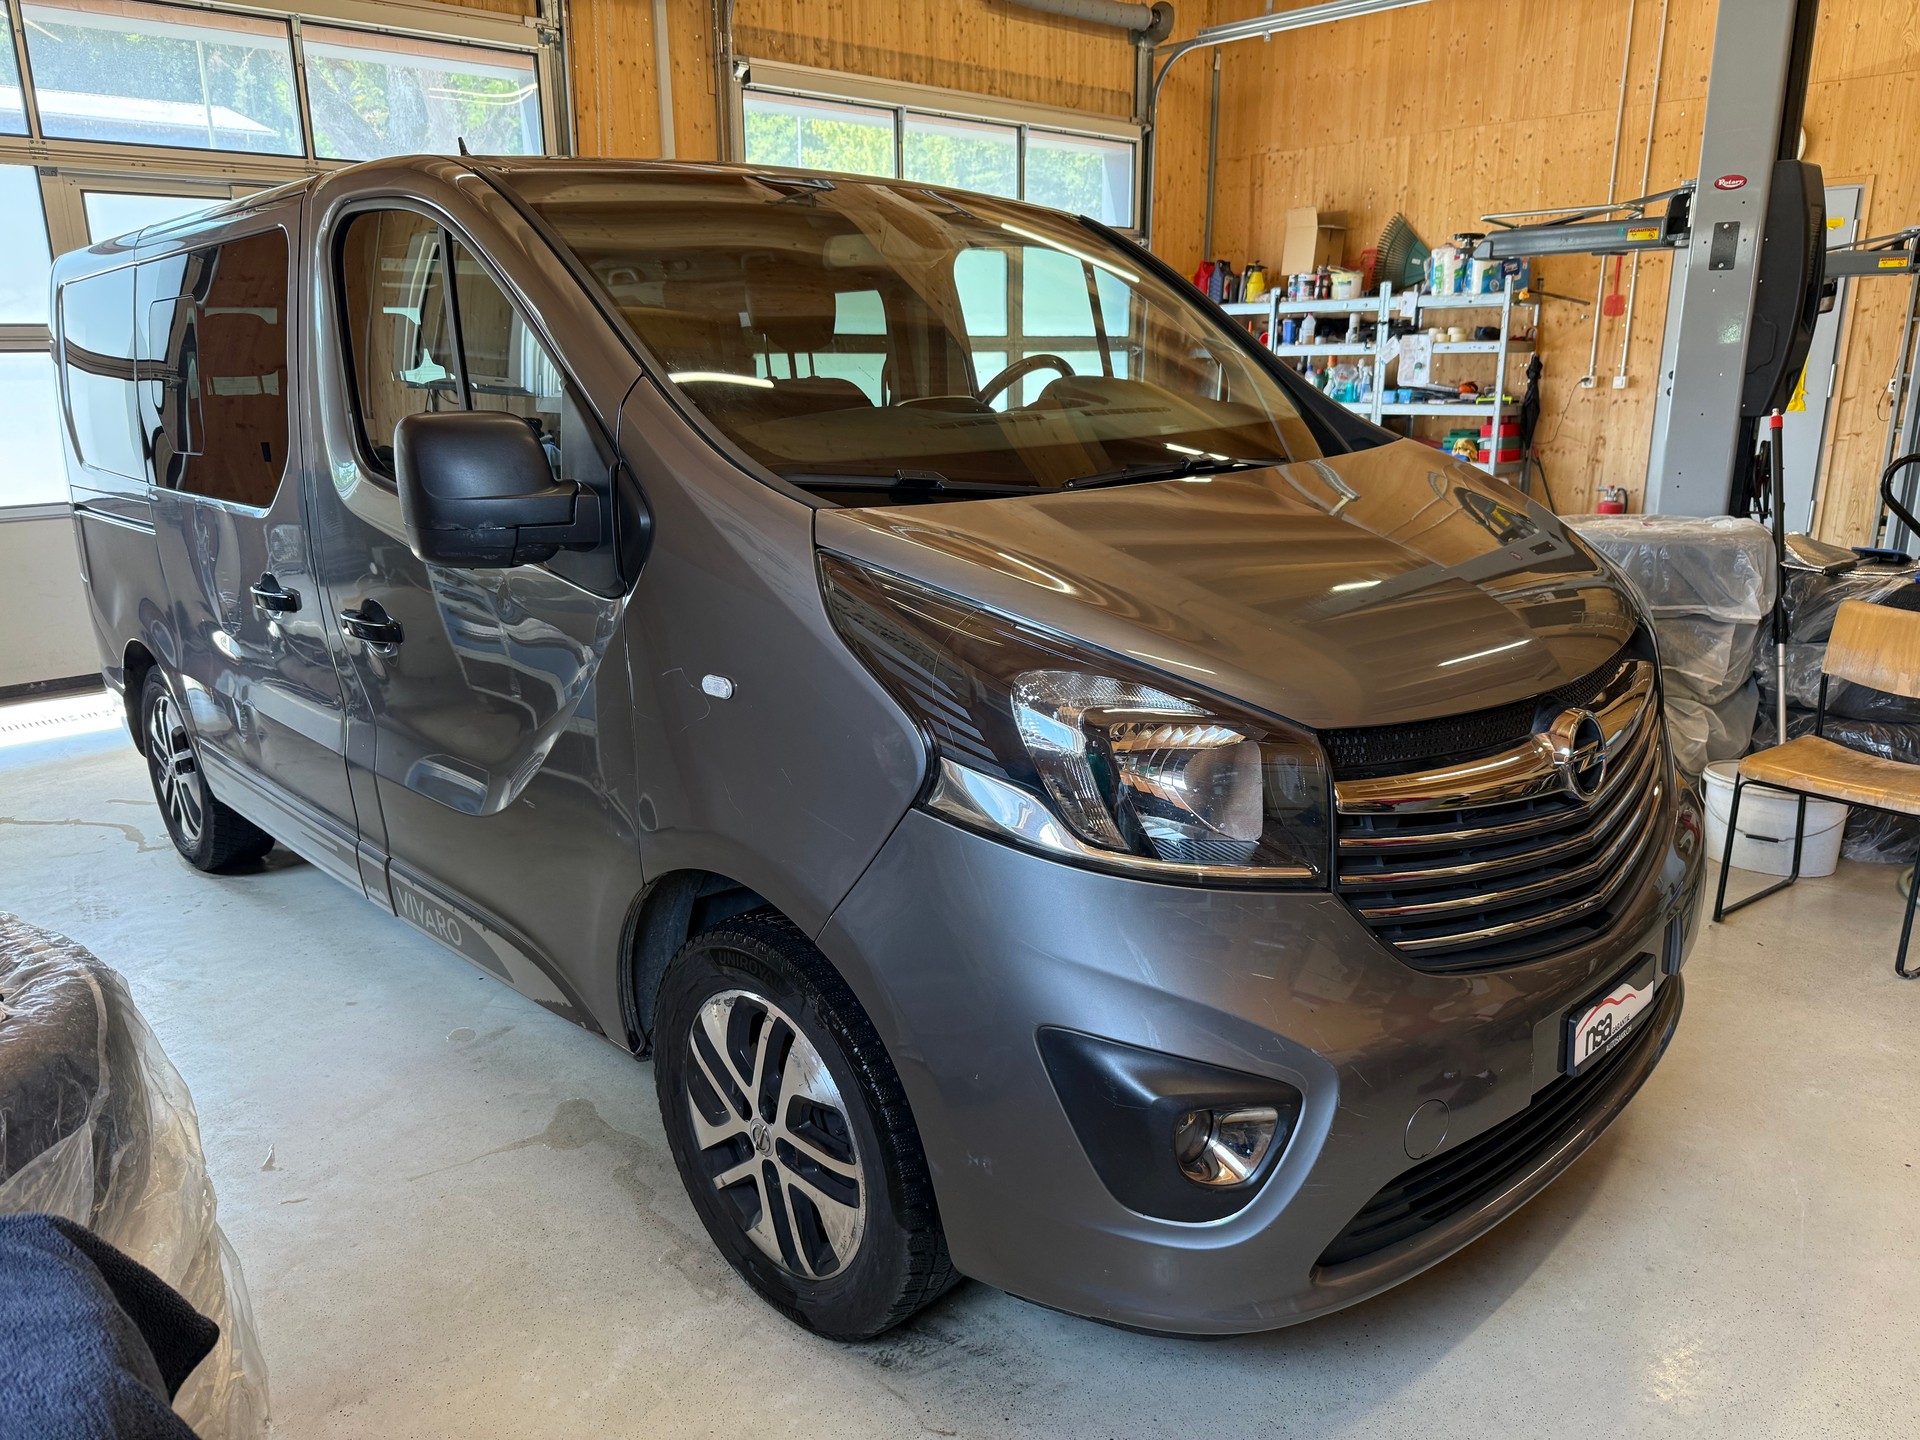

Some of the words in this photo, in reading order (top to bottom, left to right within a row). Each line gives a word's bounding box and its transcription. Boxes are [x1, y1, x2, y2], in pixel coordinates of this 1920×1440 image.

[1718, 178, 1744, 188] Rotary
[396, 886, 463, 946] VIVARO
[718, 950, 781, 988] UNIROYAL
[1585, 1012, 1613, 1053] nsa
[1612, 1013, 1630, 1035] GARANTIE
